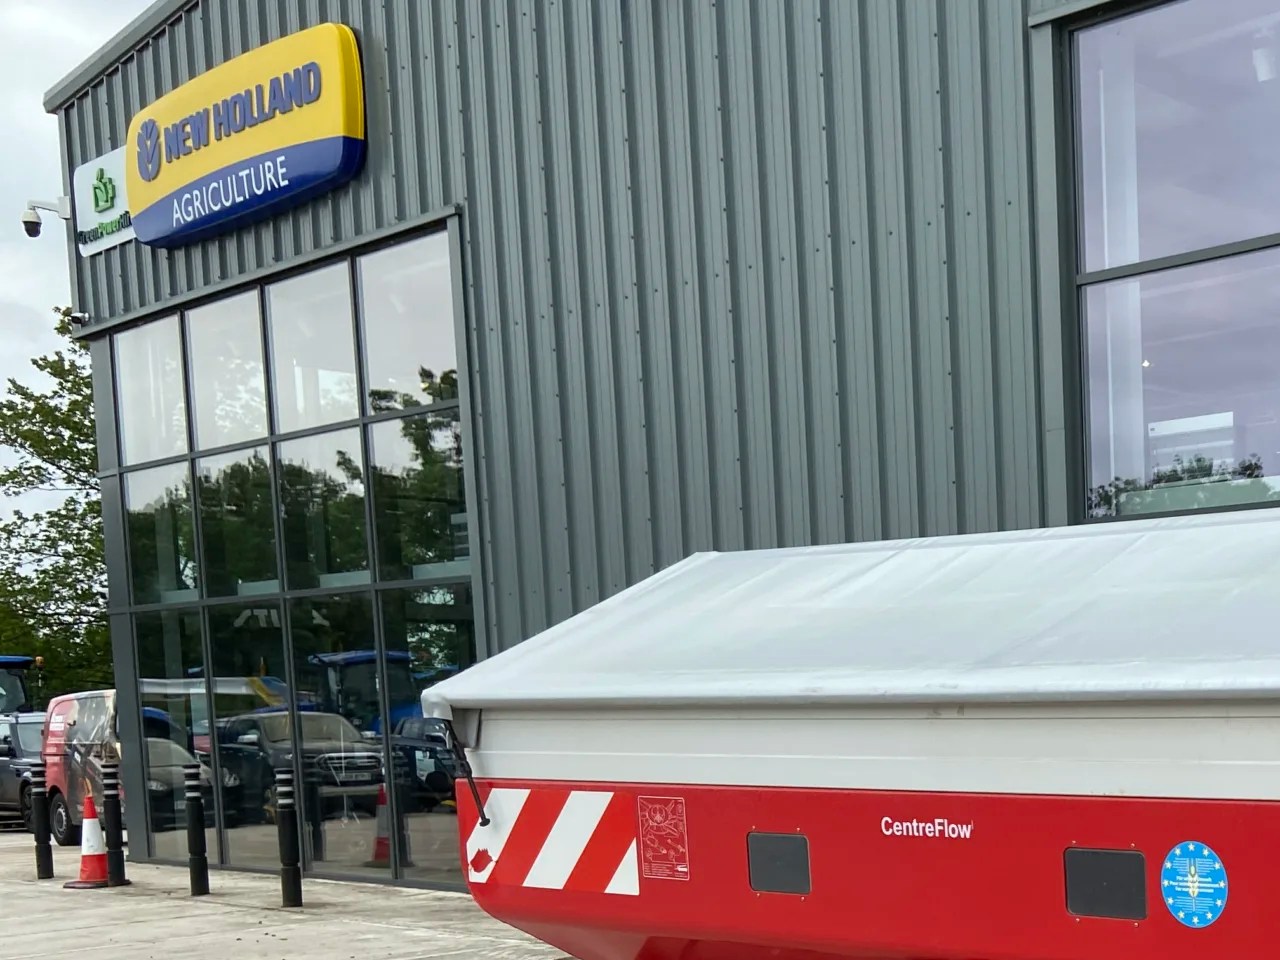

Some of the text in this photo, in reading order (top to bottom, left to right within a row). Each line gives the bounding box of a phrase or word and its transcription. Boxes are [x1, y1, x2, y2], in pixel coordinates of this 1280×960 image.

[164, 62, 322, 164] NEW HOLLAND
[173, 156, 289, 227] AGRICULTURE
[881, 816, 972, 839] CentreFlow
